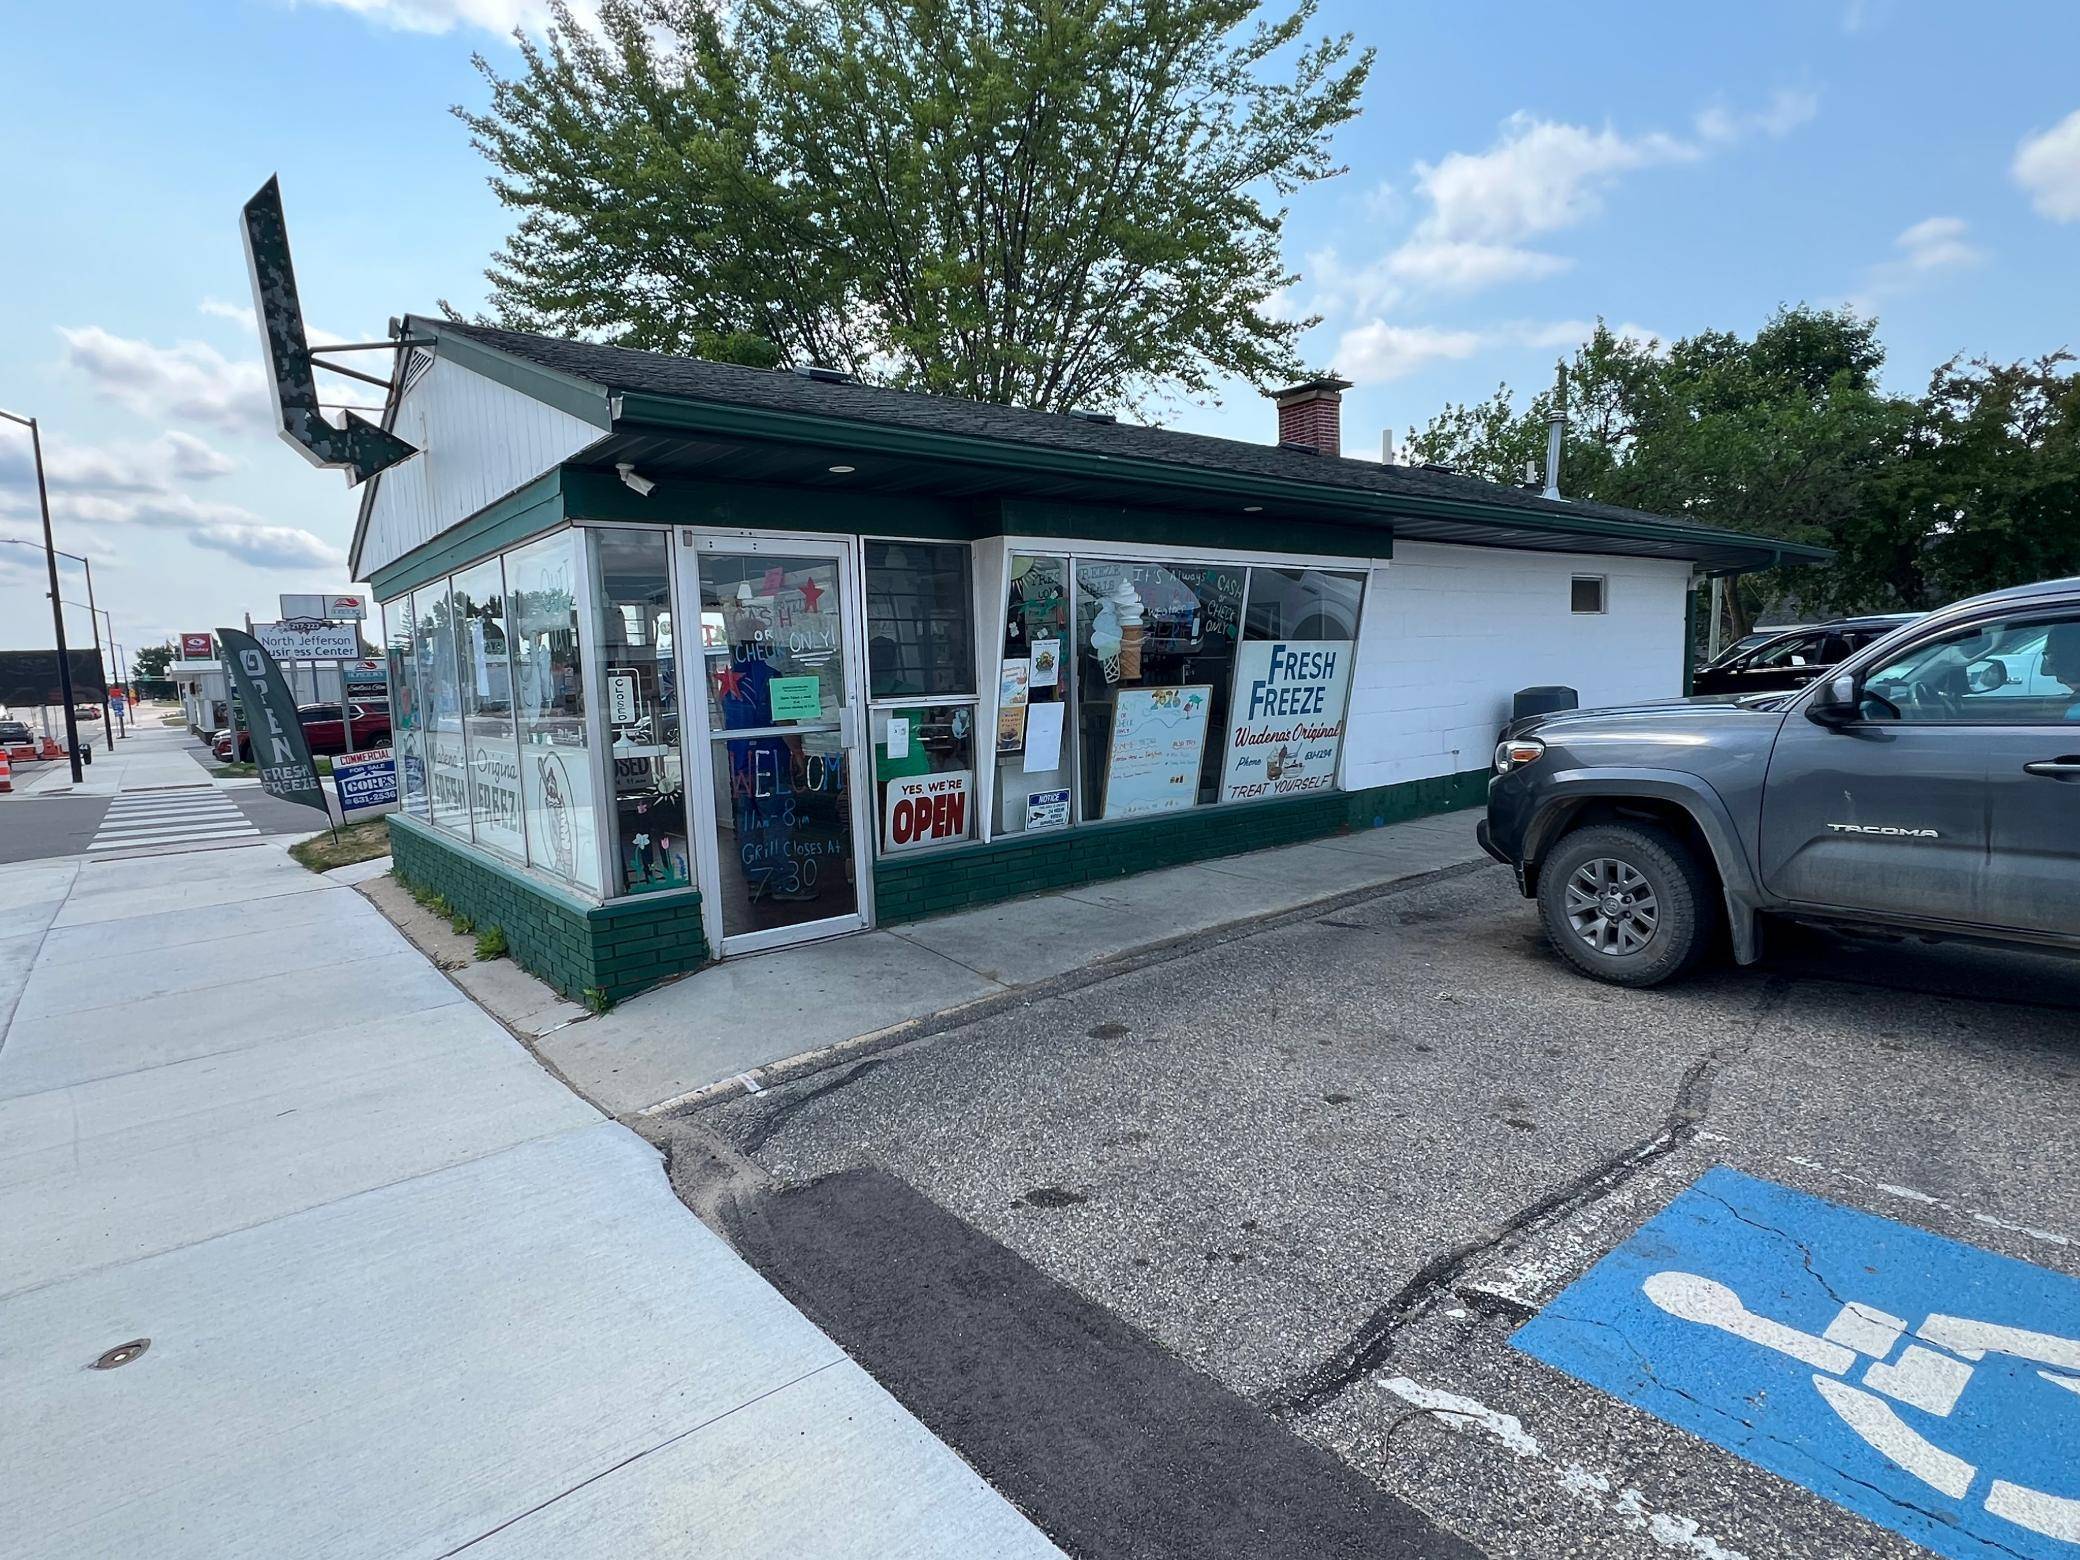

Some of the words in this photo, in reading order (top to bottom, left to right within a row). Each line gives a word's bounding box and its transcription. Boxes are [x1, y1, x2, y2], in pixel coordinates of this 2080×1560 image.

[1217, 574, 1243, 599] CASH
[1207, 600, 1236, 622] CHECK
[754, 630, 773, 641] OR
[1205, 619, 1229, 636] ONLY
[261, 635, 294, 646] North
[299, 635, 351, 646] Jefferson
[789, 624, 838, 653] ONLY!
[315, 646, 354, 656] Center
[1267, 644, 1337, 685] FRESH
[239, 649, 296, 764] OPEN
[615, 679, 628, 721] CLOSED
[1247, 680, 1326, 721] FREEZE
[1235, 724, 1291, 748] Wadena's
[1292, 719, 1342, 743] Original
[340, 750, 391, 766] COMMERCIAL
[367, 762, 386, 770] SALE
[1235, 757, 1262, 771] Phone
[261, 763, 311, 781] FRESH
[263, 777, 319, 794] FREEZE
[346, 774, 397, 792] GORES
[928, 779, 963, 793] WE'RE
[1227, 783, 1270, 799] "TREAT
[1274, 773, 1333, 793] YOURSELF"
[353, 791, 396, 805] 631-2536
[892, 792, 966, 845] OPEN
[1827, 823, 1939, 838] TACOMA
[750, 858, 817, 905] 7:30
